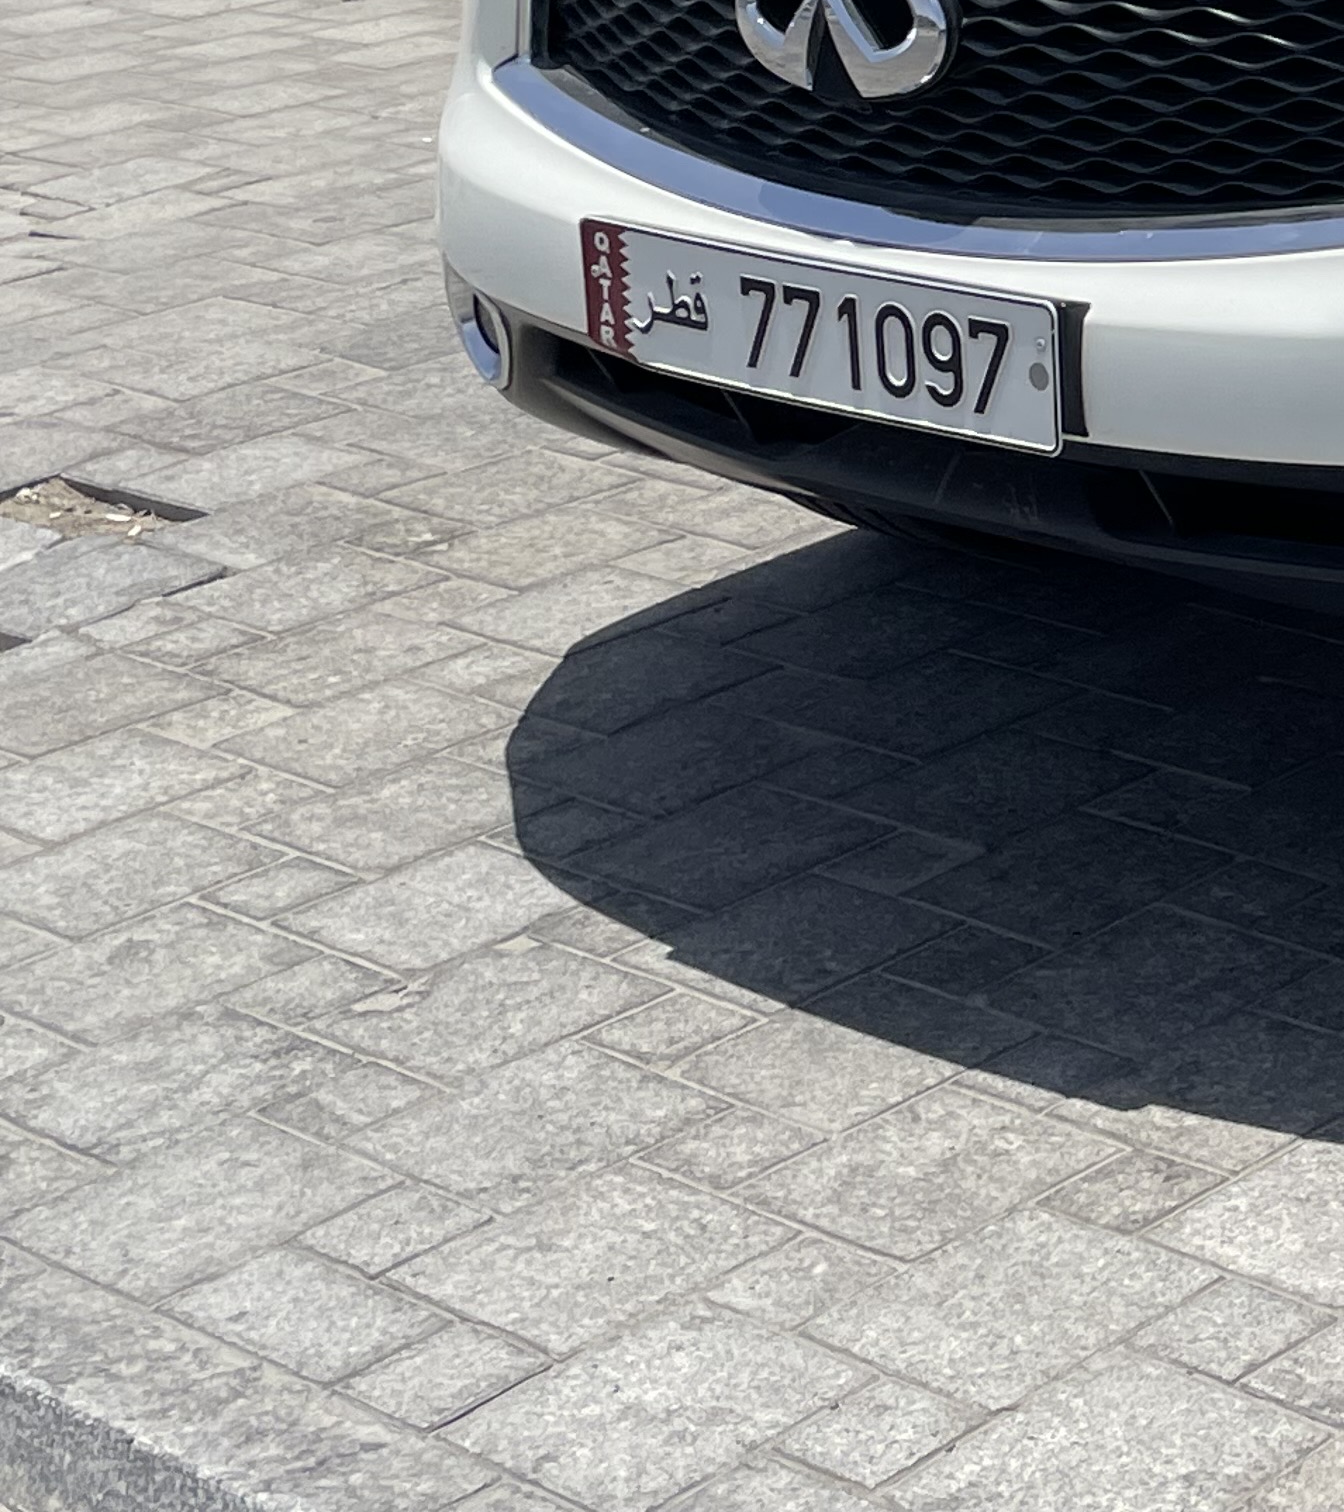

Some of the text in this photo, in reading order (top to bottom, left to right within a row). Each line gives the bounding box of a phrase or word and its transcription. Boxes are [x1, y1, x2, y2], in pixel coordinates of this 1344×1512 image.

[593, 231, 617, 348] QATAR
[632, 270, 1010, 415] قطر 771097
